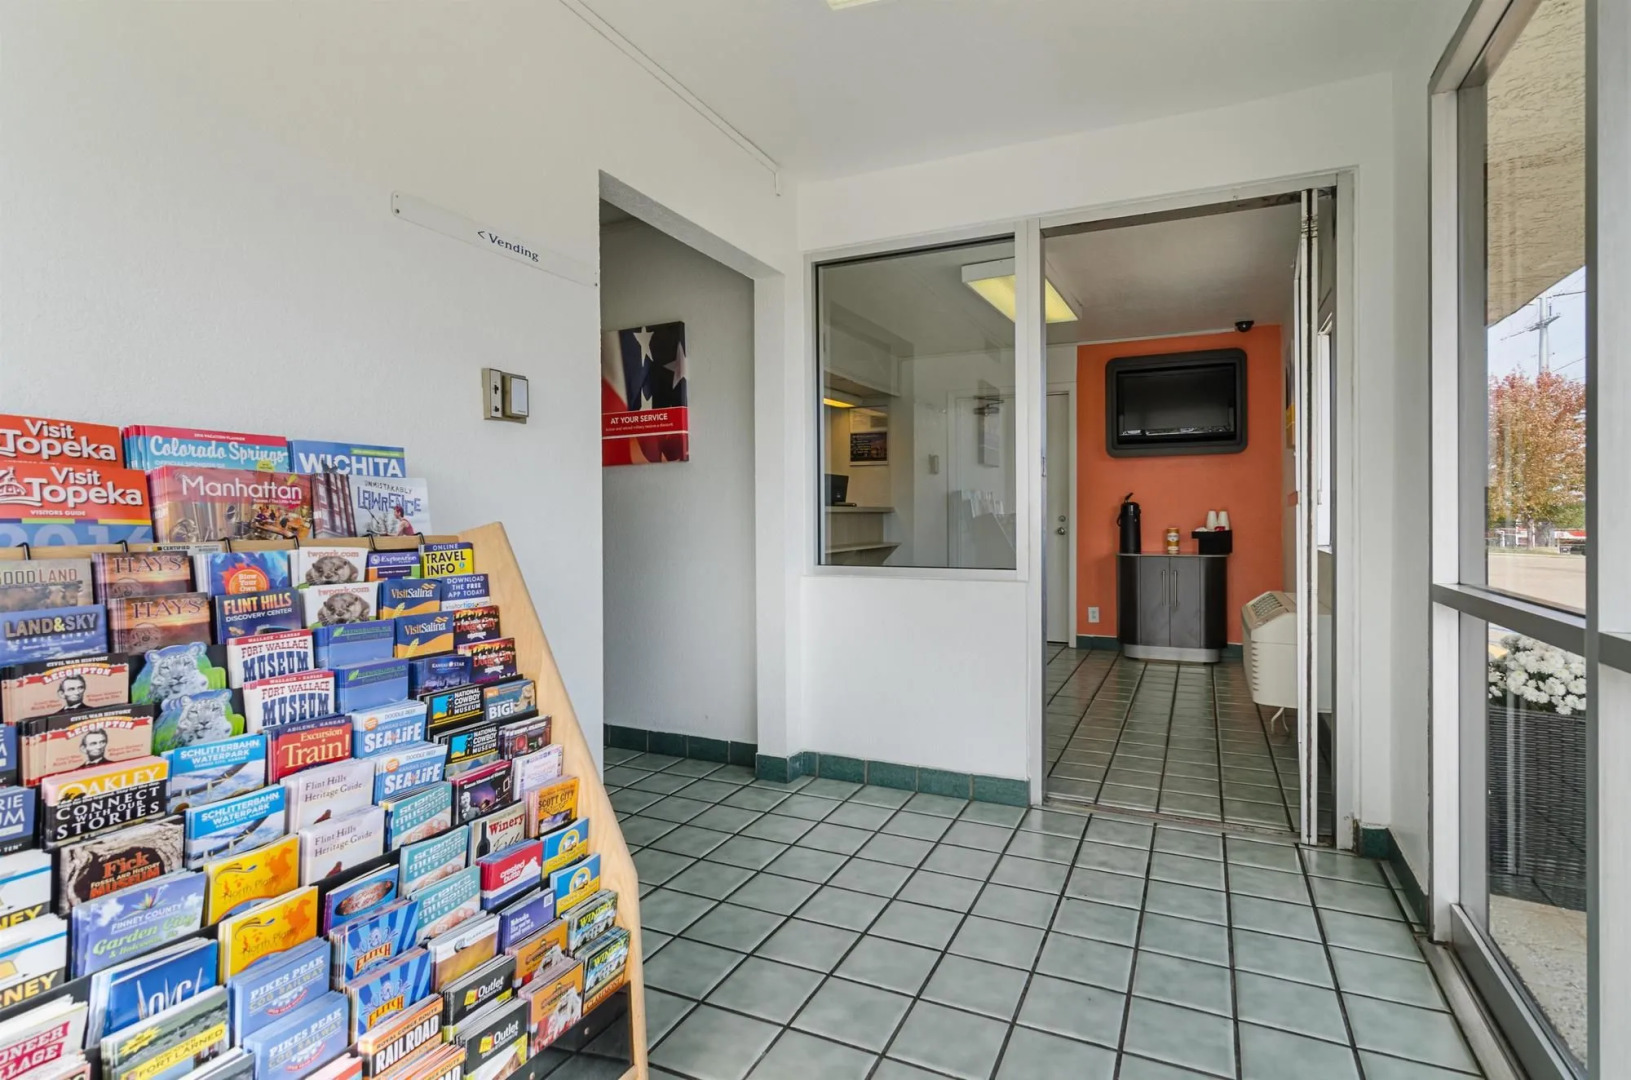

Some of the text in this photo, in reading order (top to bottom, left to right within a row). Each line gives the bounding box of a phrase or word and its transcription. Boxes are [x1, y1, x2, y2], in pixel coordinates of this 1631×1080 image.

[489, 232, 539, 263] Vending
[24, 418, 75, 440] Visit
[610, 413, 668, 425] AT YOUR SERVICE
[0, 429, 117, 461] Topeka
[150, 435, 289, 465] Colorado Springs
[50, 466, 102, 486] Visit
[299, 452, 404, 478] WICHITA
[23, 477, 144, 508] Topeka
[181, 474, 302, 500] Manhattan
[365, 480, 413, 494] UNMISTAKABLY
[425, 550, 467, 564] TRAVEL
[432, 543, 458, 551] ONLINE
[113, 557, 183, 574] HAYS
[427, 563, 455, 576] INFO
[0, 568, 77, 586] OODLAND
[446, 576, 485, 584] DOWNLOAD
[131, 599, 202, 619] HAYS
[223, 592, 293, 616] FLINT HILLS
[225, 607, 293, 623] DISCOVERY CENTER
[4, 613, 98, 639] LAND&SKY
[241, 638, 309, 659] FORT WALLACE
[248, 634, 274, 643] WALLACE
[46, 655, 109, 668] CIVIL WAR HISTORY
[242, 651, 309, 683] MUSEUM
[43, 667, 112, 685] LECOMPTON
[261, 680, 330, 700] FORT WALLACE
[454, 688, 480, 699] NATIONAL
[454, 694, 481, 706] COWBOY
[70, 714, 88, 722] CIVIL
[104, 708, 132, 717] HISTORY
[261, 692, 330, 727] MUSEUM
[454, 704, 481, 715] MUSEUM
[488, 702, 514, 720] BIG!
[67, 721, 134, 739] LECOMPTON
[300, 728, 342, 742] Excursion
[473, 726, 498, 737] NATIONAL
[473, 732, 497, 744] COWBOY
[180, 739, 260, 759] SCHLITTERBAHN
[281, 733, 350, 769] Train!
[364, 730, 393, 753] SEA
[472, 742, 497, 754] MUSEUM
[191, 749, 250, 765] WATERPARK
[59, 766, 160, 800] OAKLEY
[305, 781, 363, 802] Heritage Guide
[306, 774, 347, 791] Flint Hills
[384, 771, 413, 795] SEA
[56, 786, 160, 820] CONNECT
[201, 791, 280, 822] SCHLITTERBAHN
[400, 786, 445, 813] science
[538, 793, 559, 809] SCOTT
[560, 789, 575, 801] CITY
[56, 801, 160, 840] STORIES
[75, 800, 144, 822] WITH OUR
[212, 802, 270, 826] WATERPARK
[314, 825, 357, 846] Flint Hills
[488, 813, 526, 836] Winery
[314, 829, 373, 858] Heritage Guide
[414, 832, 463, 859] science
[103, 850, 151, 878] Fick
[116, 871, 132, 881] AND
[132, 861, 161, 875] HISTORY
[500, 859, 525, 879] crested
[423, 874, 471, 908] science
[111, 903, 181, 934] FINNEY COUNTY
[92, 925, 158, 957] Garden
[354, 942, 392, 975] ELITCH
[250, 954, 325, 1000] PIKES PEAK
[477, 975, 505, 998] Outlet
[0, 971, 57, 1009] NEY
[367, 995, 405, 1030] ELITCH
[269, 1028, 308, 1057] PIKES
[309, 1007, 343, 1033] PEAK
[376, 1006, 438, 1049] ROYAL GORGE ROUTE
[493, 1020, 519, 1045] Outlet
[139, 1055, 172, 1078] FORT
[174, 1028, 223, 1059] LARNED
[375, 1014, 440, 1075] RAILROAD
